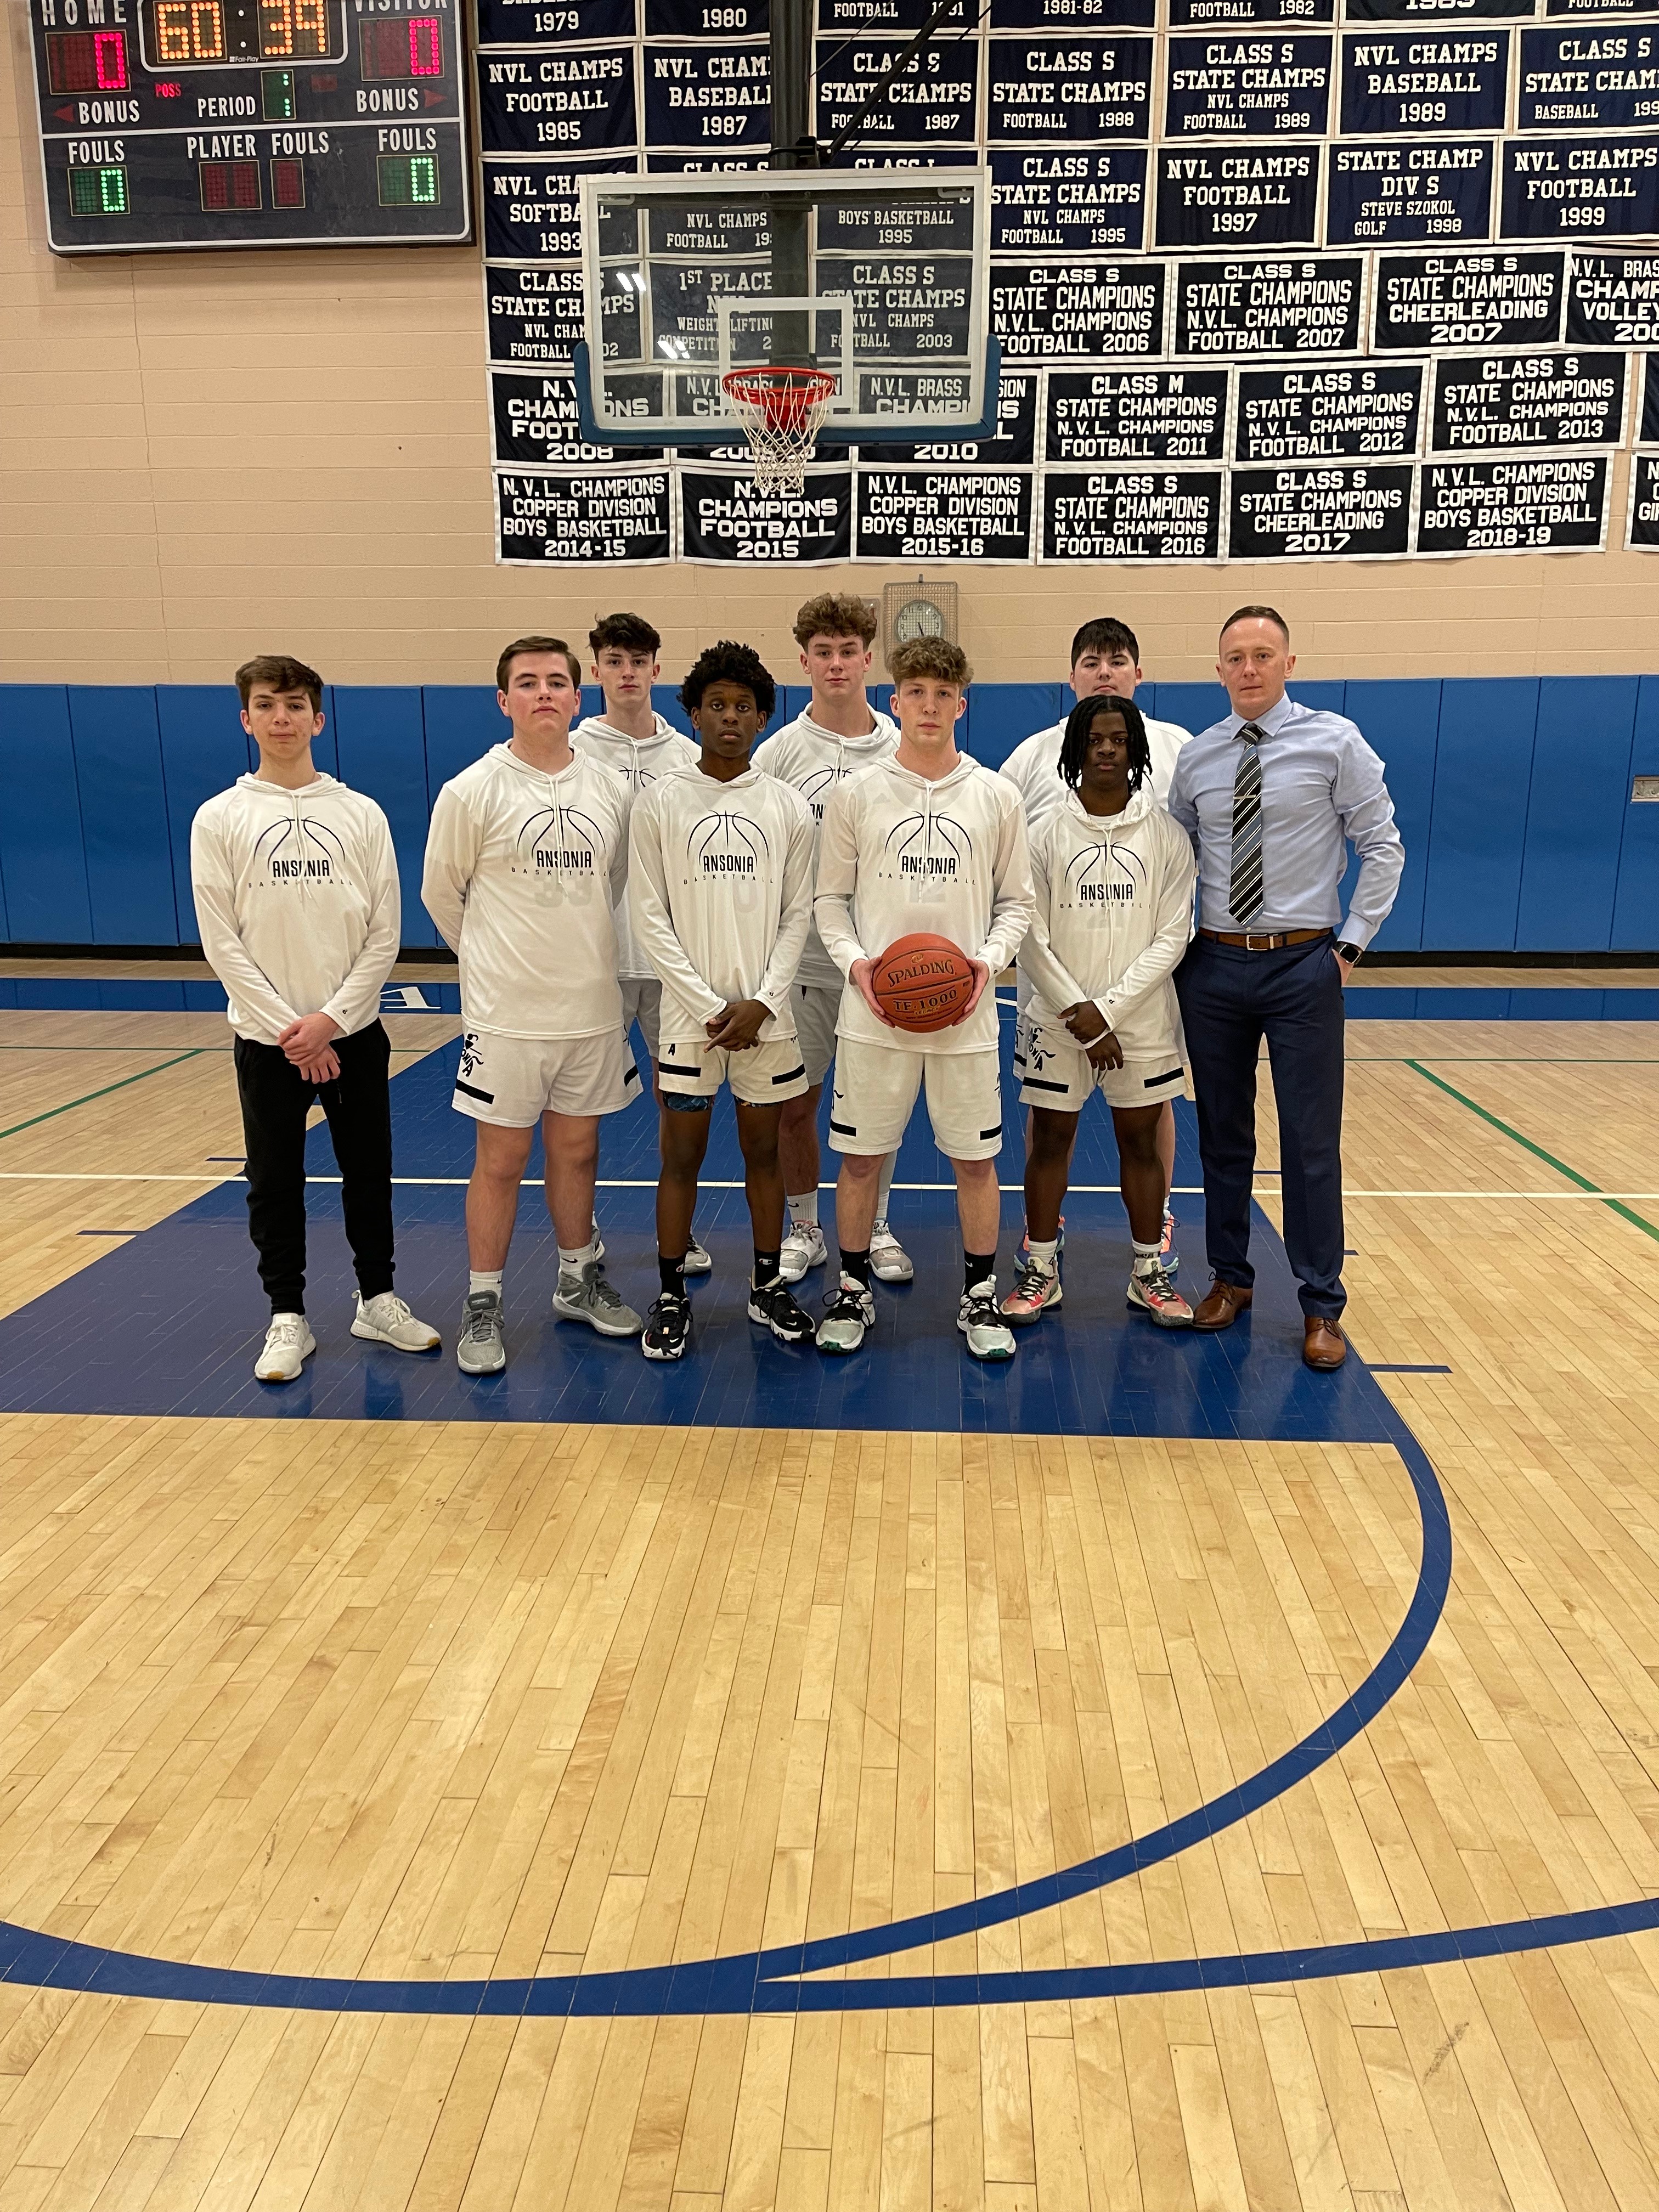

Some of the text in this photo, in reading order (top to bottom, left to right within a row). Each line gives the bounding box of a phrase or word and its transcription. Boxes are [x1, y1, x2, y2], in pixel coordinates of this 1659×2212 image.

[42, 0, 127, 26] HOME
[834, 3, 898, 18] FOOTBALL
[1043, 0, 1103, 15] 1981-82
[1190, 0, 1314, 18] FOOTBALL 1982
[534, 11, 579, 32] 1979
[702, 8, 747, 28] 1980
[409, 19, 439, 75] 0
[1206, 44, 1294, 64] CLASS S
[1355, 42, 1497, 66] NVL CHAMPS
[1559, 37, 1651, 61] CLASS S
[94, 33, 126, 89] 0
[489, 58, 623, 83] NVL CHAMPS
[654, 59, 697, 78] NVL
[1027, 51, 1115, 71] CLASS S
[155, 83, 182, 98] POSS
[1368, 73, 1480, 94] BASEBALL
[1526, 72, 1589, 93] STATE
[357, 88, 419, 112] BONUS
[506, 89, 608, 112] FOOTBALL
[889, 83, 972, 103] CHAMPS
[993, 82, 1146, 104] STATE CHAMPS
[1207, 93, 1289, 109] NVL CHAMPS
[78, 99, 140, 125] BONUS
[198, 96, 256, 117] PERIOD
[1400, 103, 1446, 122] 1989
[1535, 104, 1599, 120] BASEBALL
[702, 116, 747, 136] 1987
[926, 114, 960, 129] 1987
[1099, 112, 1134, 127] 1988
[1274, 113, 1310, 128] 1989
[379, 128, 437, 151] FOULS
[537, 121, 581, 142] 1985
[68, 140, 125, 163] FOULS
[188, 131, 329, 159] PLAYER FOULS
[1023, 157, 1110, 178] CLASS S
[1167, 157, 1310, 179] NVL CHAMPS
[1337, 149, 1483, 171] STATE CHAMP
[1515, 148, 1658, 172] NVL CHAMPS
[410, 157, 435, 201] 0
[494, 177, 537, 195] NVL
[1381, 176, 1439, 196] DIV. S
[1527, 178, 1637, 199] FOOTBALL
[100, 169, 126, 212] 0
[1183, 185, 1290, 206] FOOTBALL
[874, 210, 954, 225] BASKETBALL
[1361, 200, 1455, 217] STEVE SZOKOL
[1560, 206, 1605, 227] 1999
[687, 212, 767, 228] NVL CHAMPS
[1212, 213, 1258, 233] 1997
[1355, 218, 1462, 236] GOLF 1998
[540, 232, 582, 251] 1993
[667, 233, 728, 249] FOOTBALL
[878, 229, 913, 244] 1995
[1001, 228, 1126, 244] FOOTBALL 1995
[853, 266, 935, 284] CLASS S
[1224, 263, 1316, 279] CLASS S
[520, 273, 583, 291] CLASS
[711, 272, 772, 291] PLACE
[1387, 274, 1554, 301] STATE CHAMPIONS
[492, 296, 549, 317] STATE
[885, 289, 965, 308] CHAMPS
[992, 285, 1155, 311] STATE CHAMPIONS
[888, 313, 934, 327] CHAMPS
[1389, 300, 1548, 323] CHEERLEADING
[916, 334, 952, 348] 2003
[1188, 329, 1344, 350] FOOTBALL 2007
[1430, 323, 1503, 343] 2007
[510, 343, 571, 358] FOOTBALL
[1000, 334, 1149, 353] FOOTBALL 2006
[1482, 357, 1578, 380] CLASS S
[871, 377, 962, 396] N.V.L. BRASS
[1092, 375, 1183, 395] CLASS M
[1444, 379, 1614, 404] STATE CHAMPIONS
[1450, 419, 1604, 444] FOOTBALL 2013
[914, 443, 978, 460] 2010
[1061, 437, 1207, 457] FOOTBALL 2011
[1249, 432, 1403, 458] FOOTBALL 2012
[1276, 470, 1367, 490] CLASS S
[1492, 462, 1595, 484] CHAMPIONS
[571, 476, 664, 498] CHAMPIONS
[926, 477, 1021, 495] CHAMPIONS
[1437, 484, 1587, 508] COPPER DIVISION
[513, 498, 656, 517] COPPER DIVISION
[698, 498, 837, 518] CHAMPIONS
[1424, 504, 1596, 528] BOYS BASKETBALL
[504, 517, 667, 538] BOYS BASKETBALL
[701, 519, 835, 538] FOOTBALL
[1254, 511, 1384, 533] CHEERLEADING
[901, 538, 984, 556] 2015-16
[1056, 537, 1205, 555] FOOTBALL 2016
[1285, 533, 1351, 552] 2017
[1466, 527, 1551, 547] 2018-19
[545, 539, 625, 557] 2014-15
[737, 540, 799, 558] 2015
[703, 855, 753, 873] ANSONIA
[879, 872, 975, 885] BASKTBALL
[888, 959, 955, 988] SPALDING
